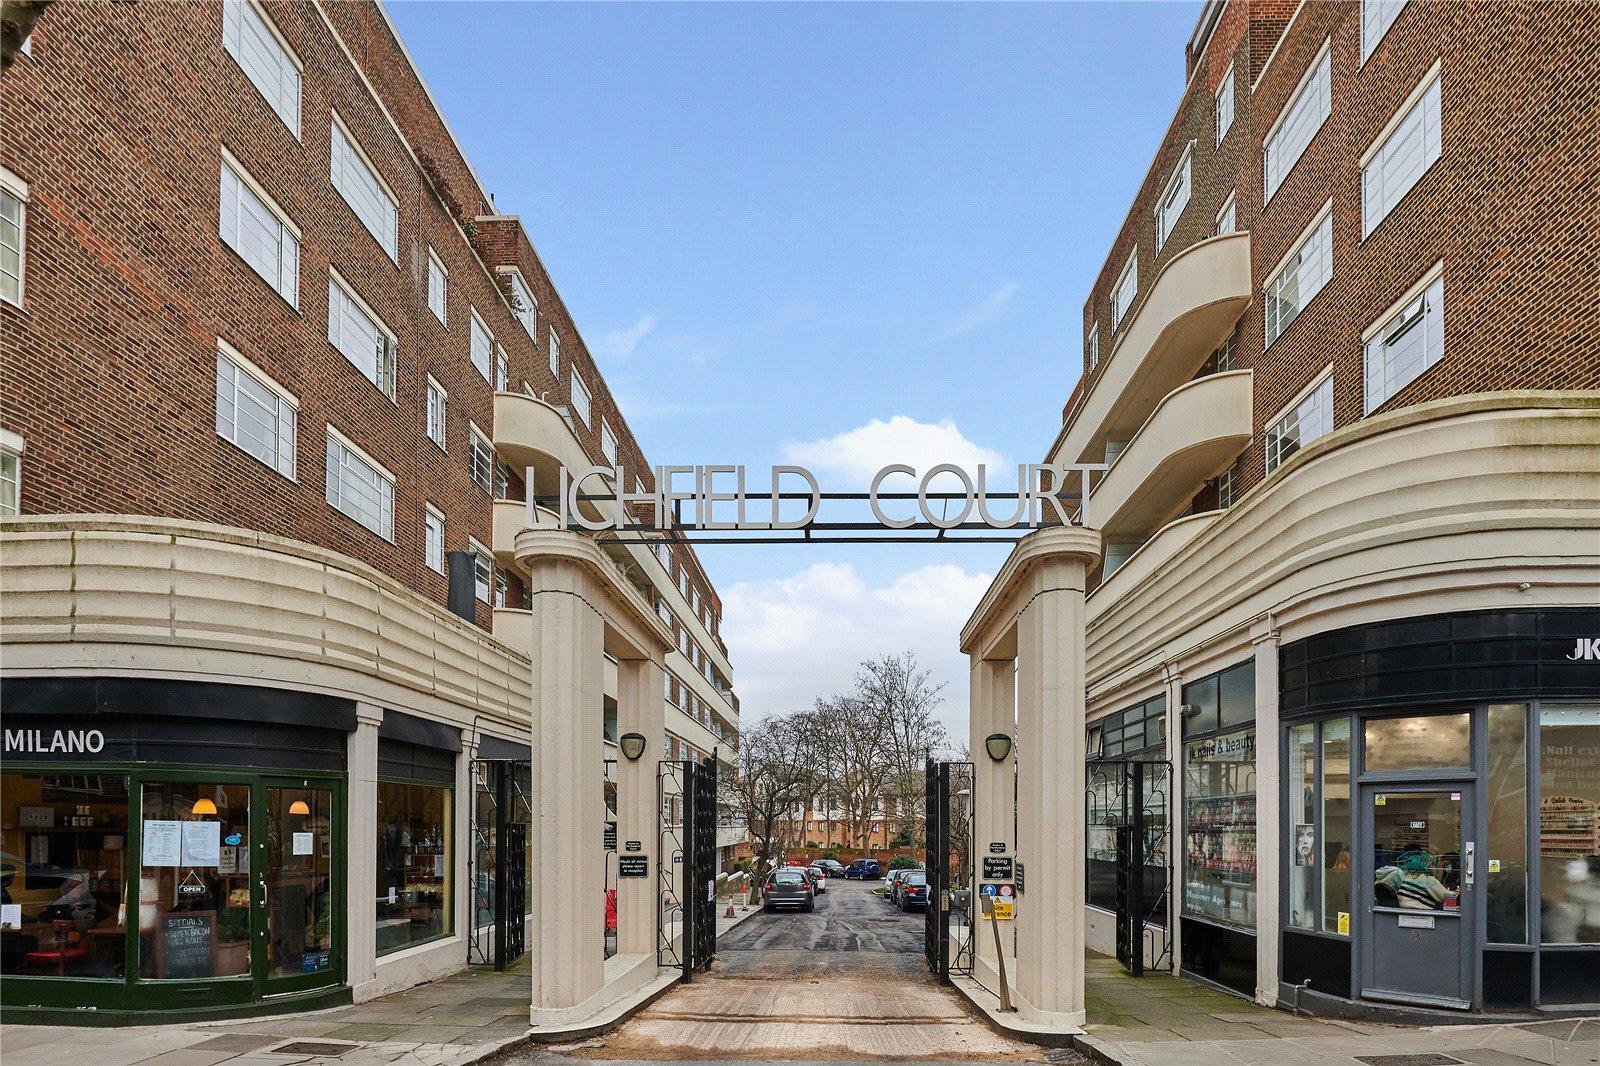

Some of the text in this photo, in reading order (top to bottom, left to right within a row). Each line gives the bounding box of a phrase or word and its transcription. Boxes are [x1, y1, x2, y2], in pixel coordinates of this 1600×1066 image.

[525, 463, 1108, 531] LICHFIELD COURT
[5, 729, 105, 753] MILANO
[1197, 742, 1215, 758] nails
[1217, 739, 1224, 754] &
[1225, 733, 1255, 752] beauty
[987, 857, 1008, 866] Parking
[991, 871, 1003, 879] only
[168, 917, 203, 927] SPECIALS
[190, 927, 210, 937] BACON
